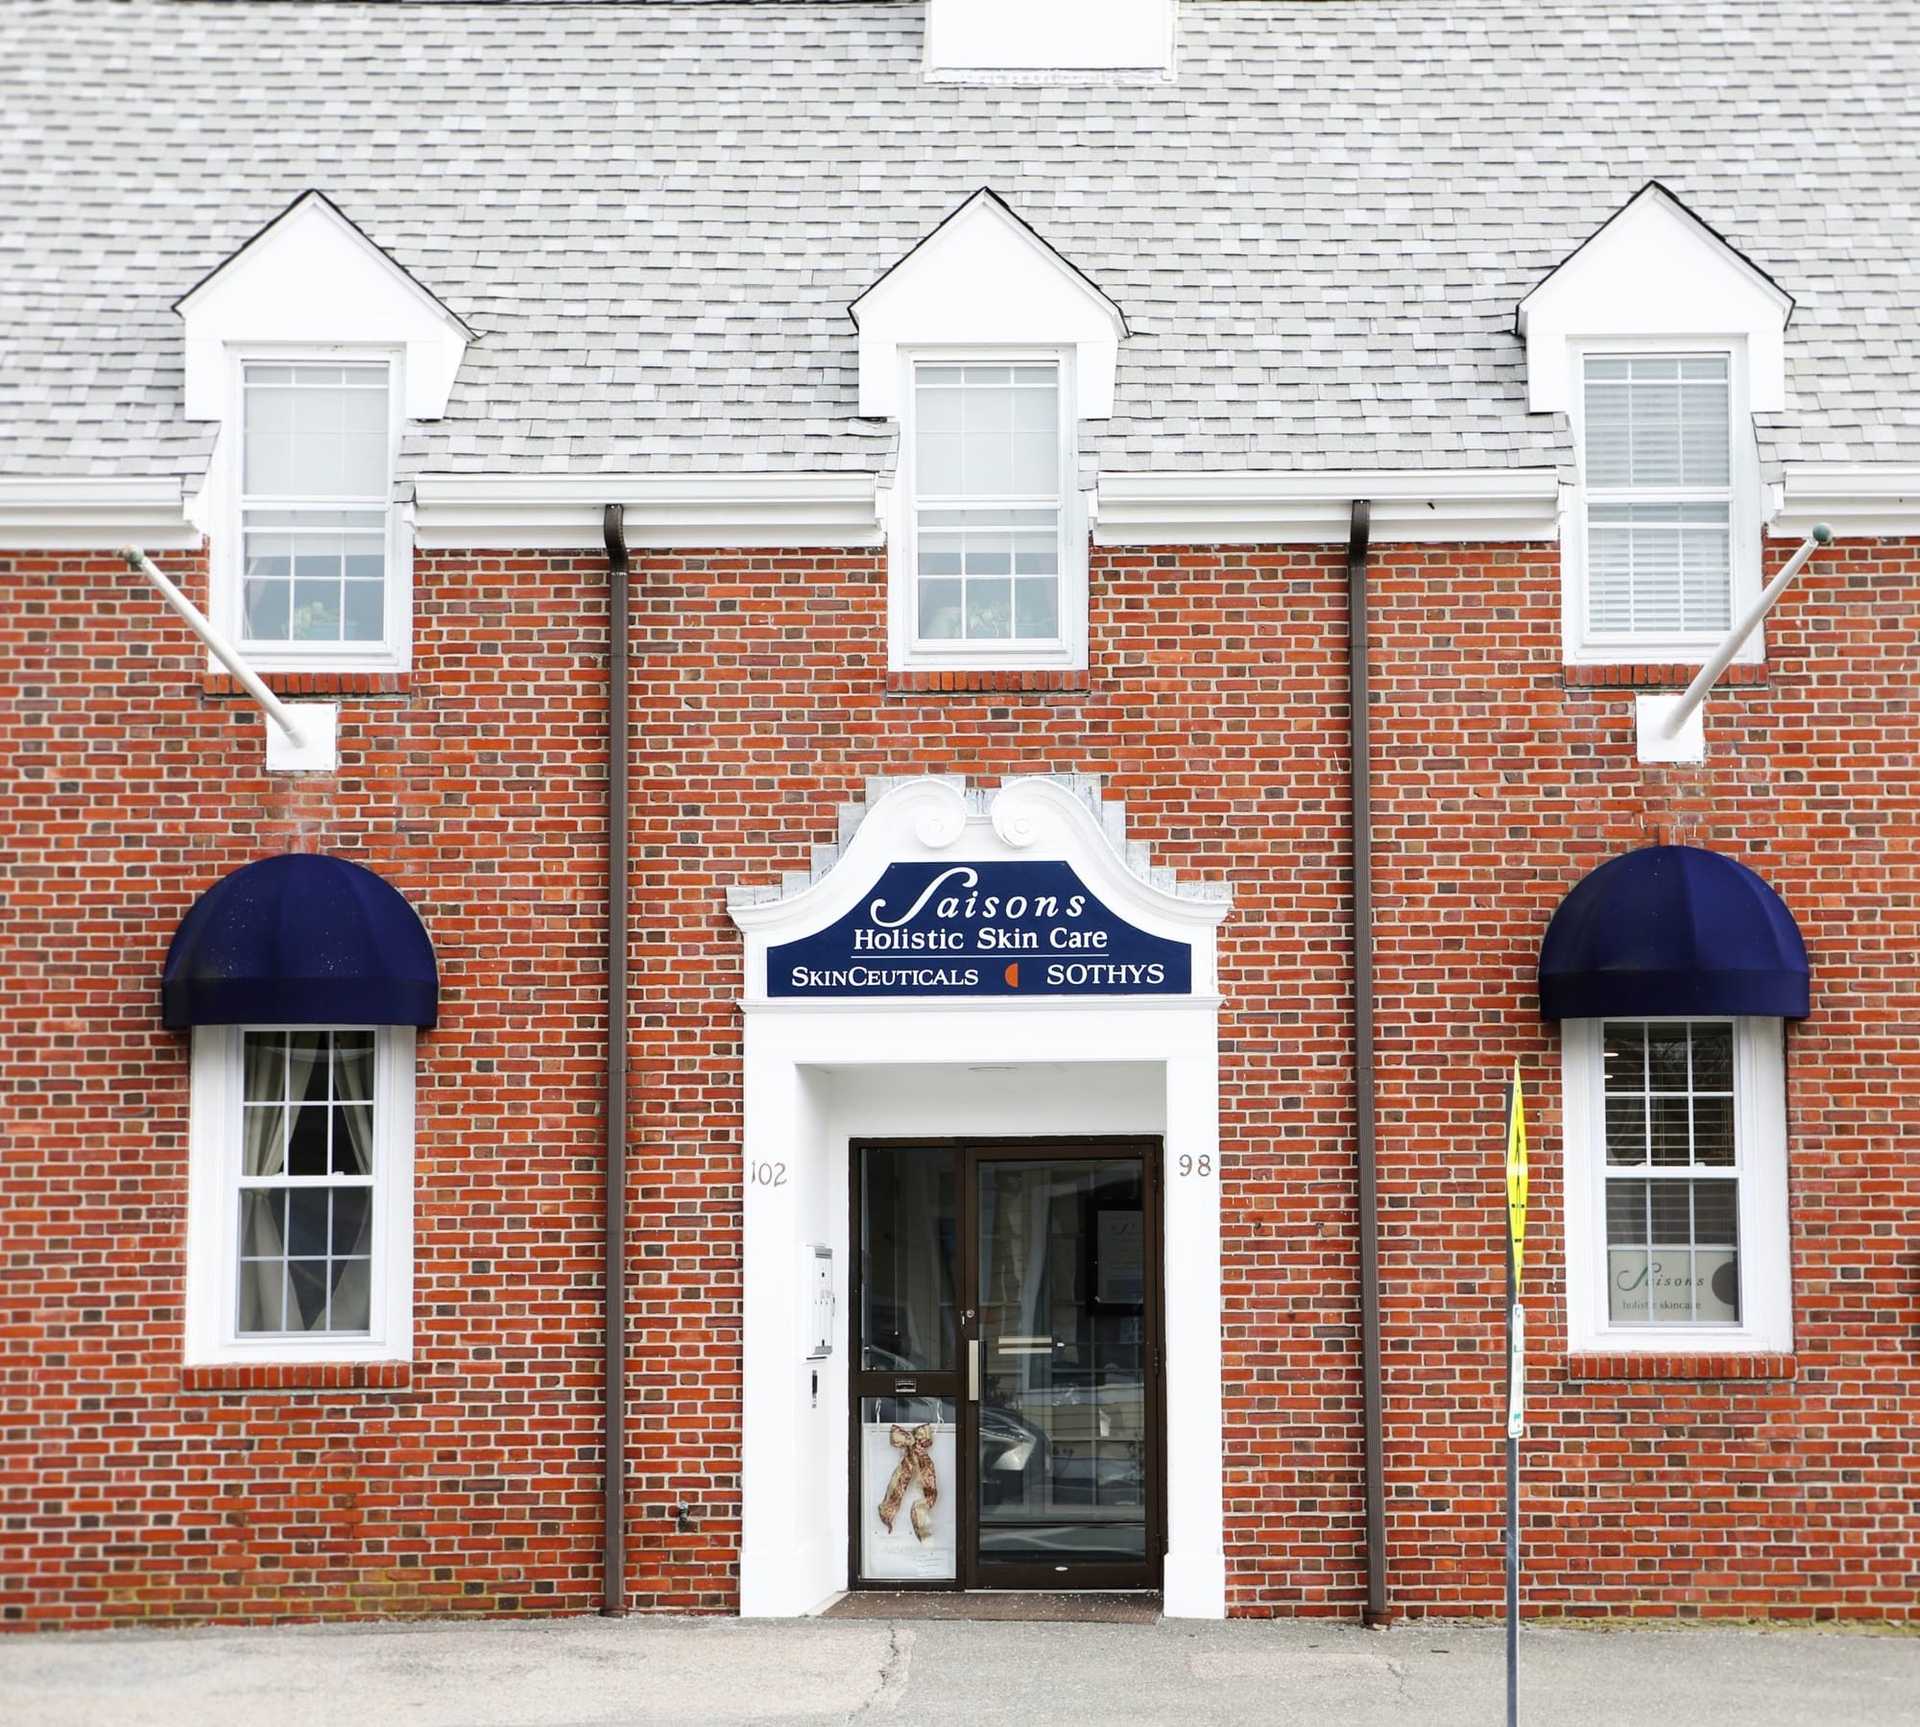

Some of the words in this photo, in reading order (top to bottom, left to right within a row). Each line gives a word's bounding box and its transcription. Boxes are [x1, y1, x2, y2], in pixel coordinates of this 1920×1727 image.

[870, 866, 1086, 927] Saisons
[853, 927, 964, 951] Holistic
[976, 926, 1038, 950] Skin
[1049, 926, 1108, 949] Care
[791, 966, 979, 988] SKINCEUTICALS
[1046, 963, 1165, 985] SOTHYS
[751, 1161, 787, 1187] 102
[1179, 1153, 1211, 1177] 98
[1622, 1300, 1657, 1310] holistc
[1660, 1300, 1702, 1310] skincae
